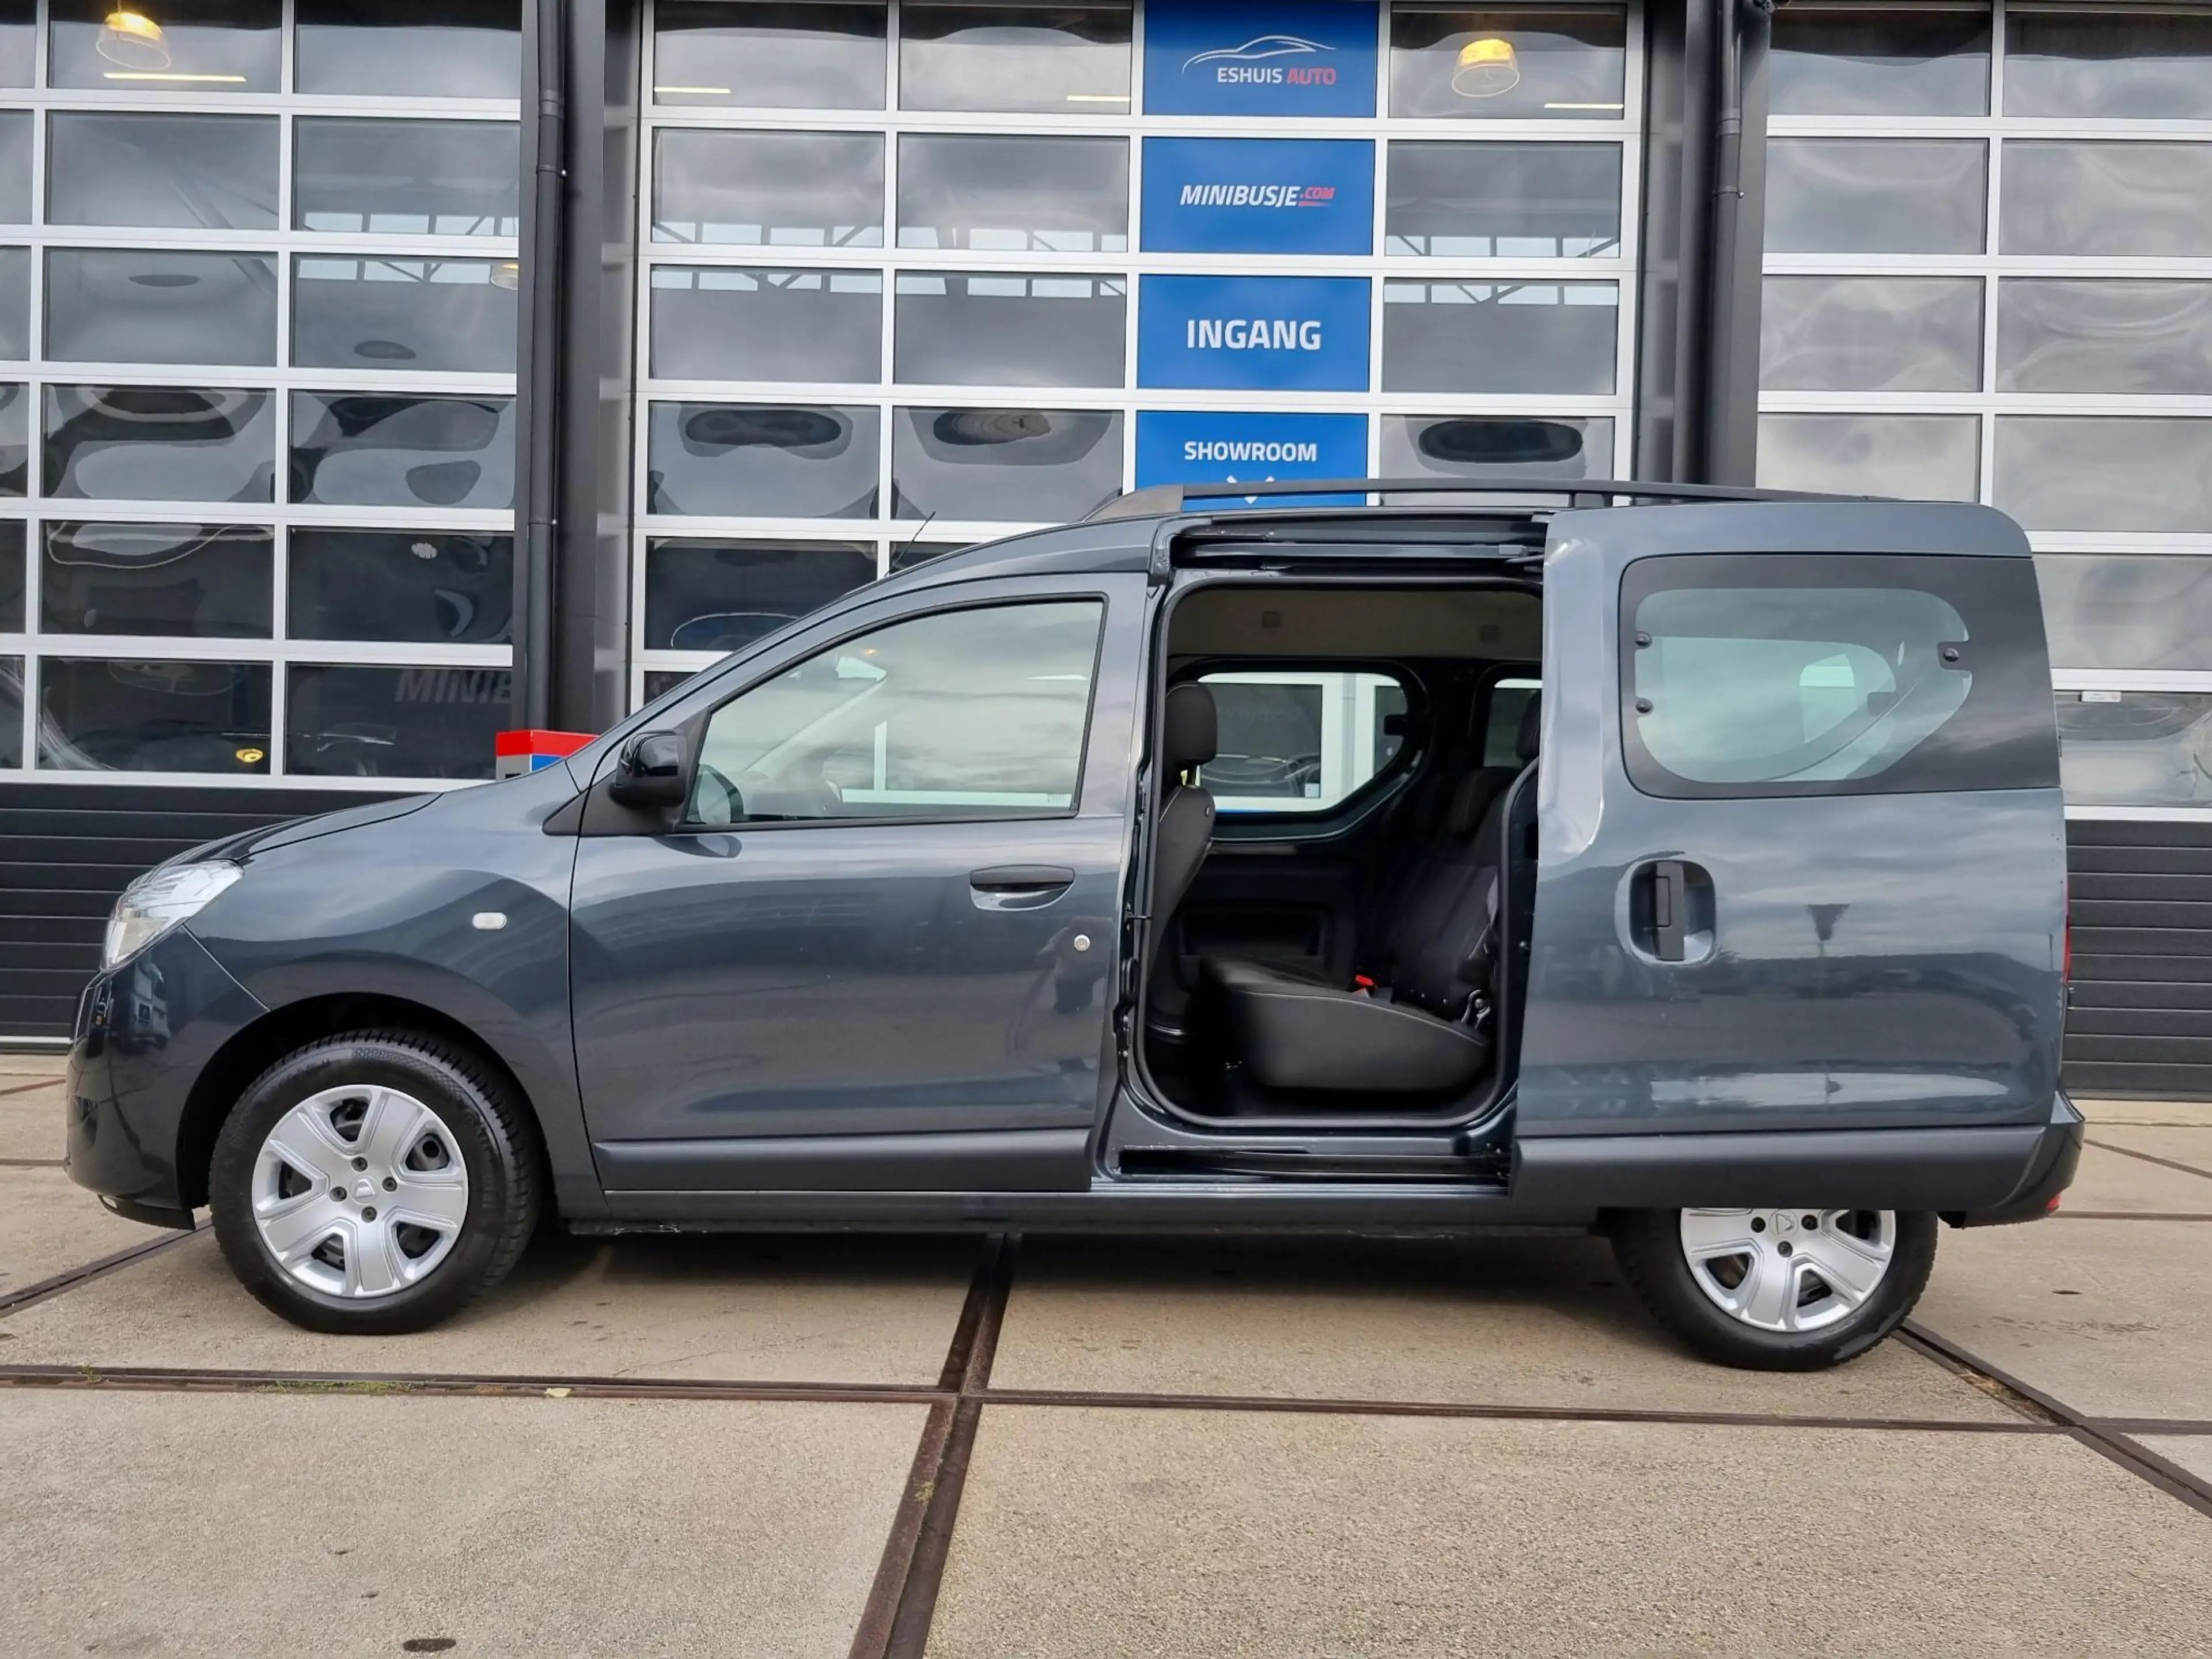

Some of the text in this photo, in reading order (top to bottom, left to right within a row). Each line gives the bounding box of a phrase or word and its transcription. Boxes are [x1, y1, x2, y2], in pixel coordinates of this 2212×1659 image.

[1217, 67, 1336, 85] ESHUIS AUTO
[1187, 320, 1321, 350] INGANG
[1184, 441, 1317, 461] SHOWROOM
